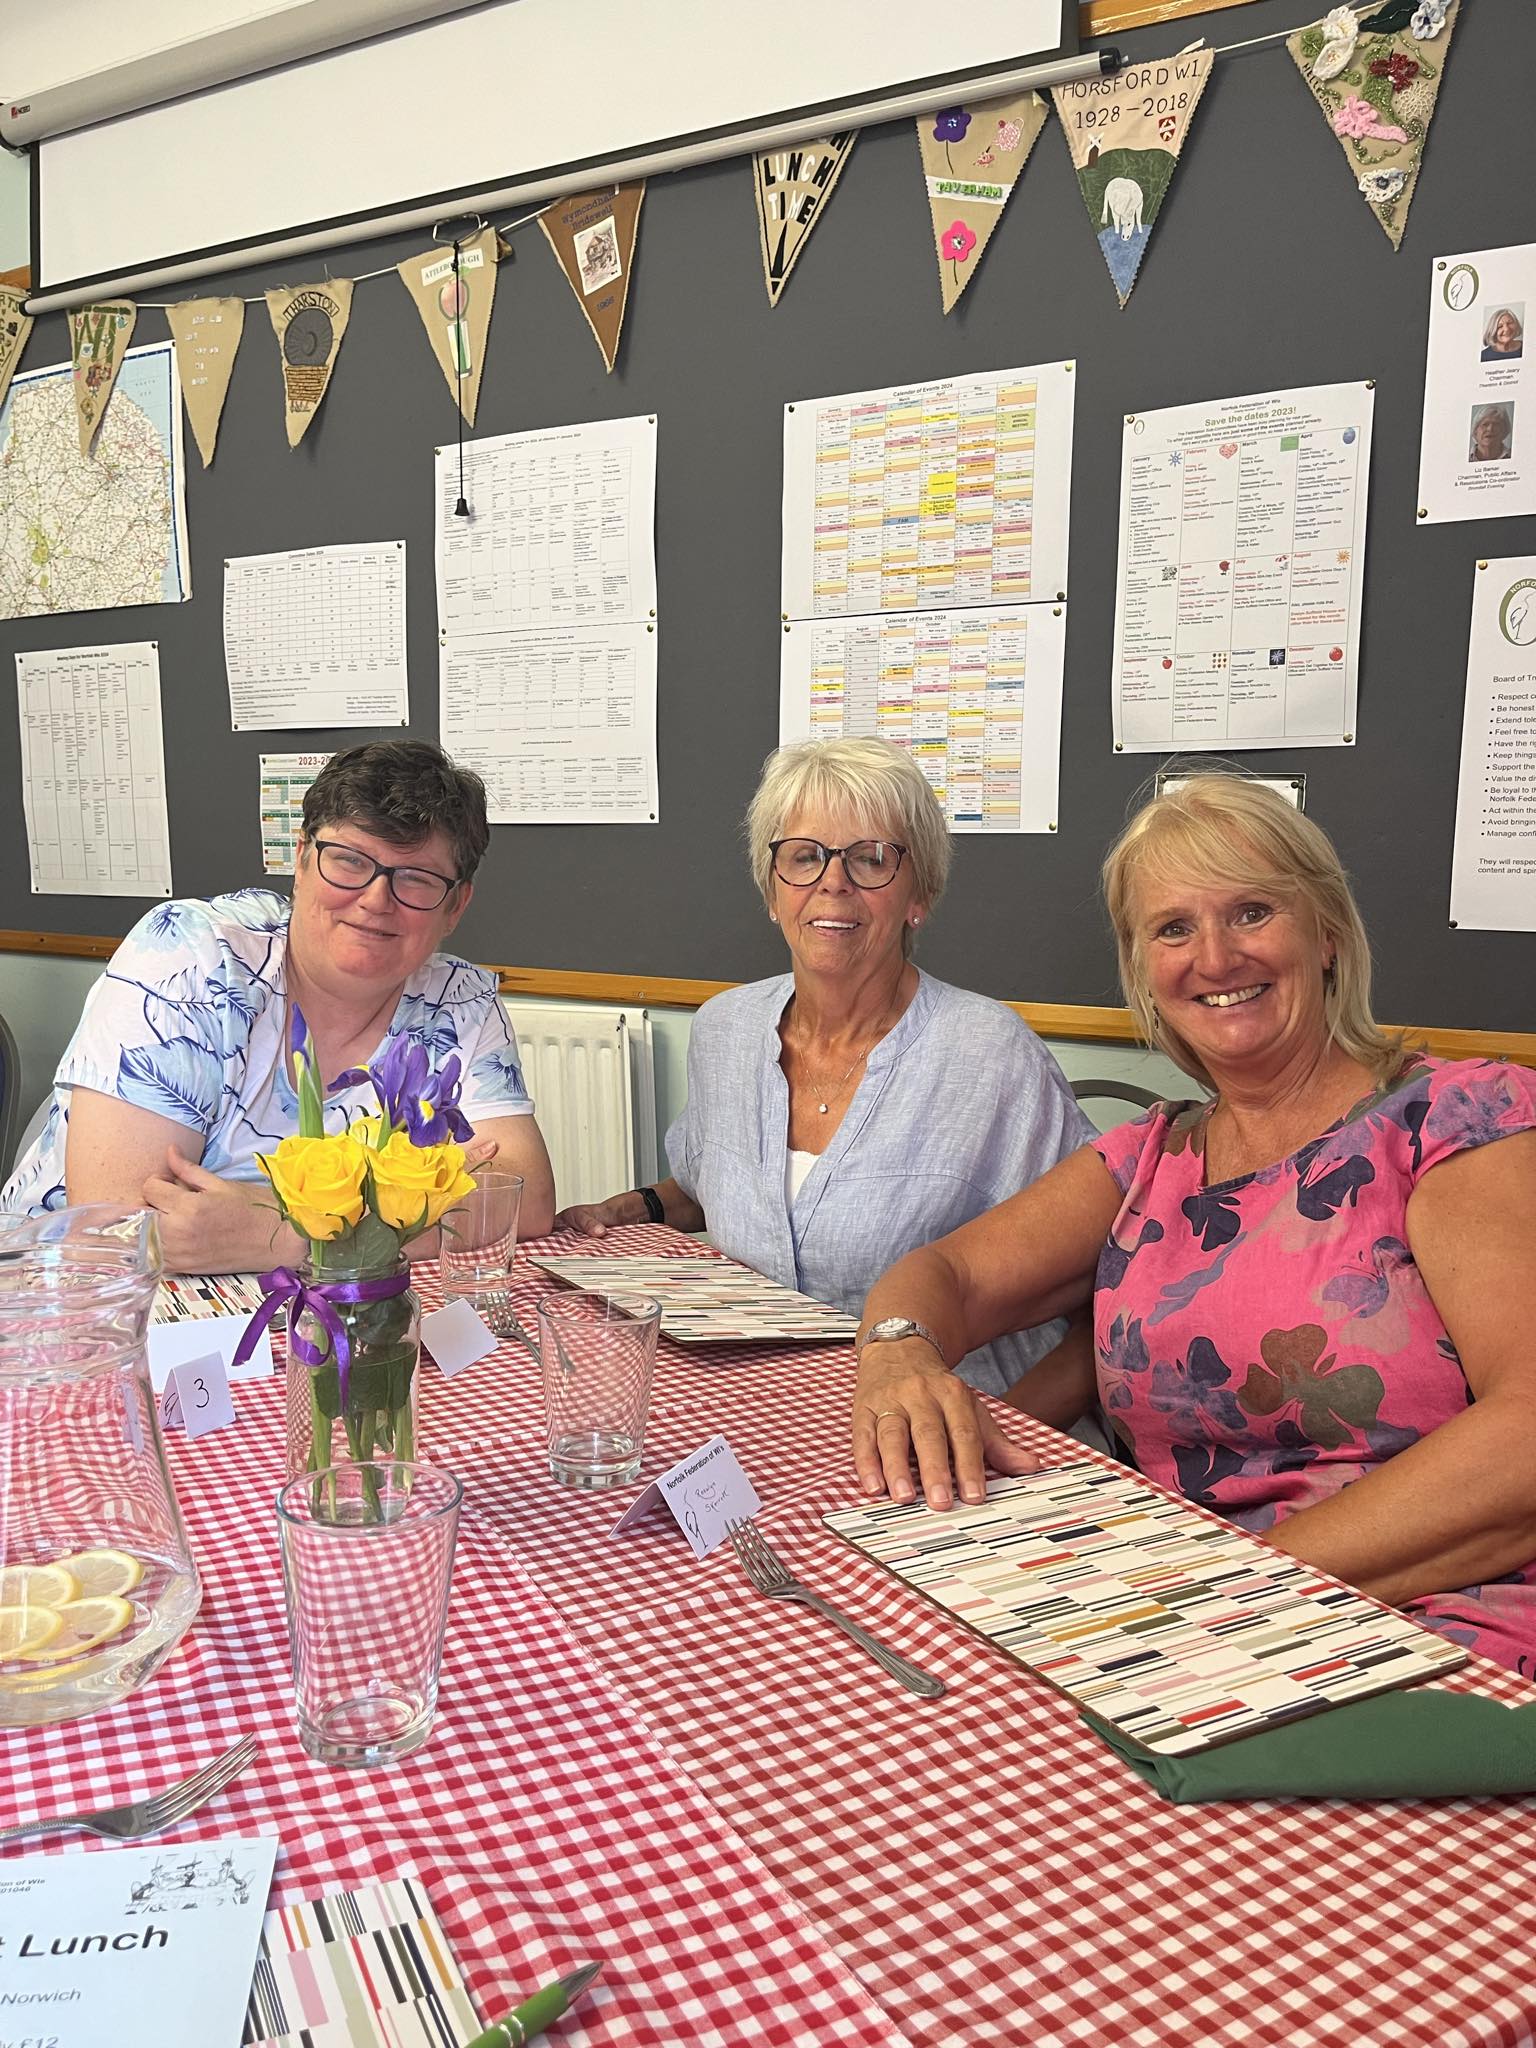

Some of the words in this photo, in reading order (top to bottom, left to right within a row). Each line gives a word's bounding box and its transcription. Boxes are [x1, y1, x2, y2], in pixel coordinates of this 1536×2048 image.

[1062, 67, 1168, 99] HORSFORD
[1303, 63, 1335, 118] HELLESDON
[1076, 107, 1121, 129] 1928
[1143, 92, 1189, 117] 2018
[763, 152, 835, 188] LUNCH
[935, 181, 1002, 198] TAVERHAM
[767, 190, 816, 225] TIME
[283, 291, 340, 321] THARSTON
[1204, 417, 1226, 427] Save
[1228, 414, 1242, 423] the
[1244, 411, 1269, 421] dates
[1271, 407, 1297, 417] 2023!
[1510, 580, 1536, 594] NORFO
[1493, 675, 1516, 683] Board
[1498, 693, 1529, 701] Respect
[1496, 716, 1522, 724] Extend
[1493, 752, 1512, 760] Keep
[1492, 763, 1522, 771] Support
[1502, 787, 1520, 795] loyal
[1487, 830, 1517, 838] Manage
[1480, 858, 1497, 866] They
[193, 1378, 210, 1408] 3
[666, 1471, 686, 1490] Norfolk
[684, 1454, 710, 1477] Federation
[708, 1451, 715, 1461] of
[19, 1925, 169, 1958] Lunch
[1, 1988, 82, 2006] Norwich
[20, 2036, 59, 2048] £12
